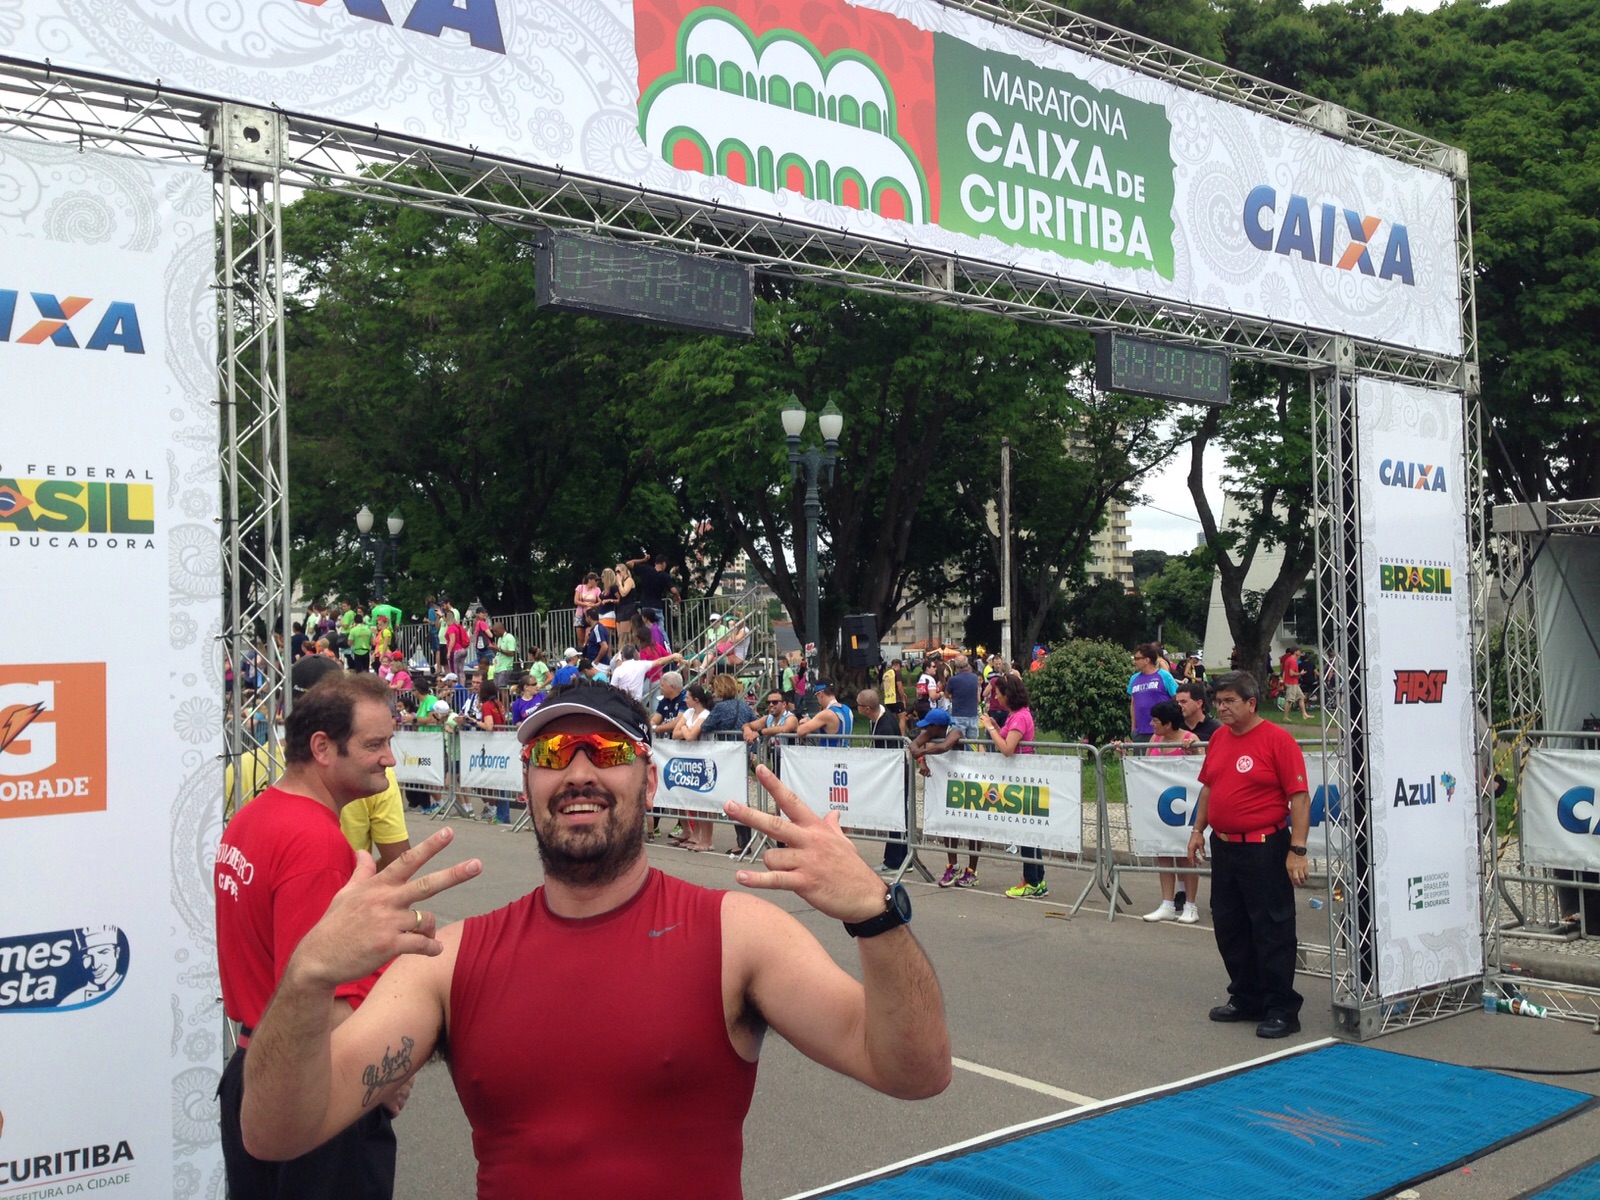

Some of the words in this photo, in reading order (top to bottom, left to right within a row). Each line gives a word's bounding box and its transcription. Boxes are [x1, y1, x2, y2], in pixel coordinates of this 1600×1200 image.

[983, 65, 1128, 140] MARATONA
[966, 111, 1114, 195] CAIXA
[1116, 169, 1146, 203] DE
[959, 173, 1154, 261] CURITIBA
[1243, 184, 1416, 286] CAIXA
[27, 464, 153, 480] FEDERAL
[1379, 458, 1447, 493] CAIXA
[0, 536, 154, 549] DUCADORA
[1379, 556, 1415, 565] GOVERNO
[1419, 559, 1451, 568] FEDERAL
[1380, 564, 1452, 594] BRASIL
[1411, 594, 1453, 602] EDUCADORA
[1393, 669, 1448, 705] FIRST
[670, 759, 702, 773] Gomes
[674, 772, 700, 787] Costa
[833, 770, 848, 786] GO
[947, 771, 995, 781] GOVERNO
[1001, 775, 1050, 785] FEDERAL
[946, 779, 1050, 817] BRASIL
[1393, 775, 1436, 808] Azul
[945, 809, 979, 819] PÁTRIA
[988, 813, 1050, 826] EDUCADORA
[66, 1182, 84, 1195] DA
[87, 1173, 130, 1190] CIDADE
